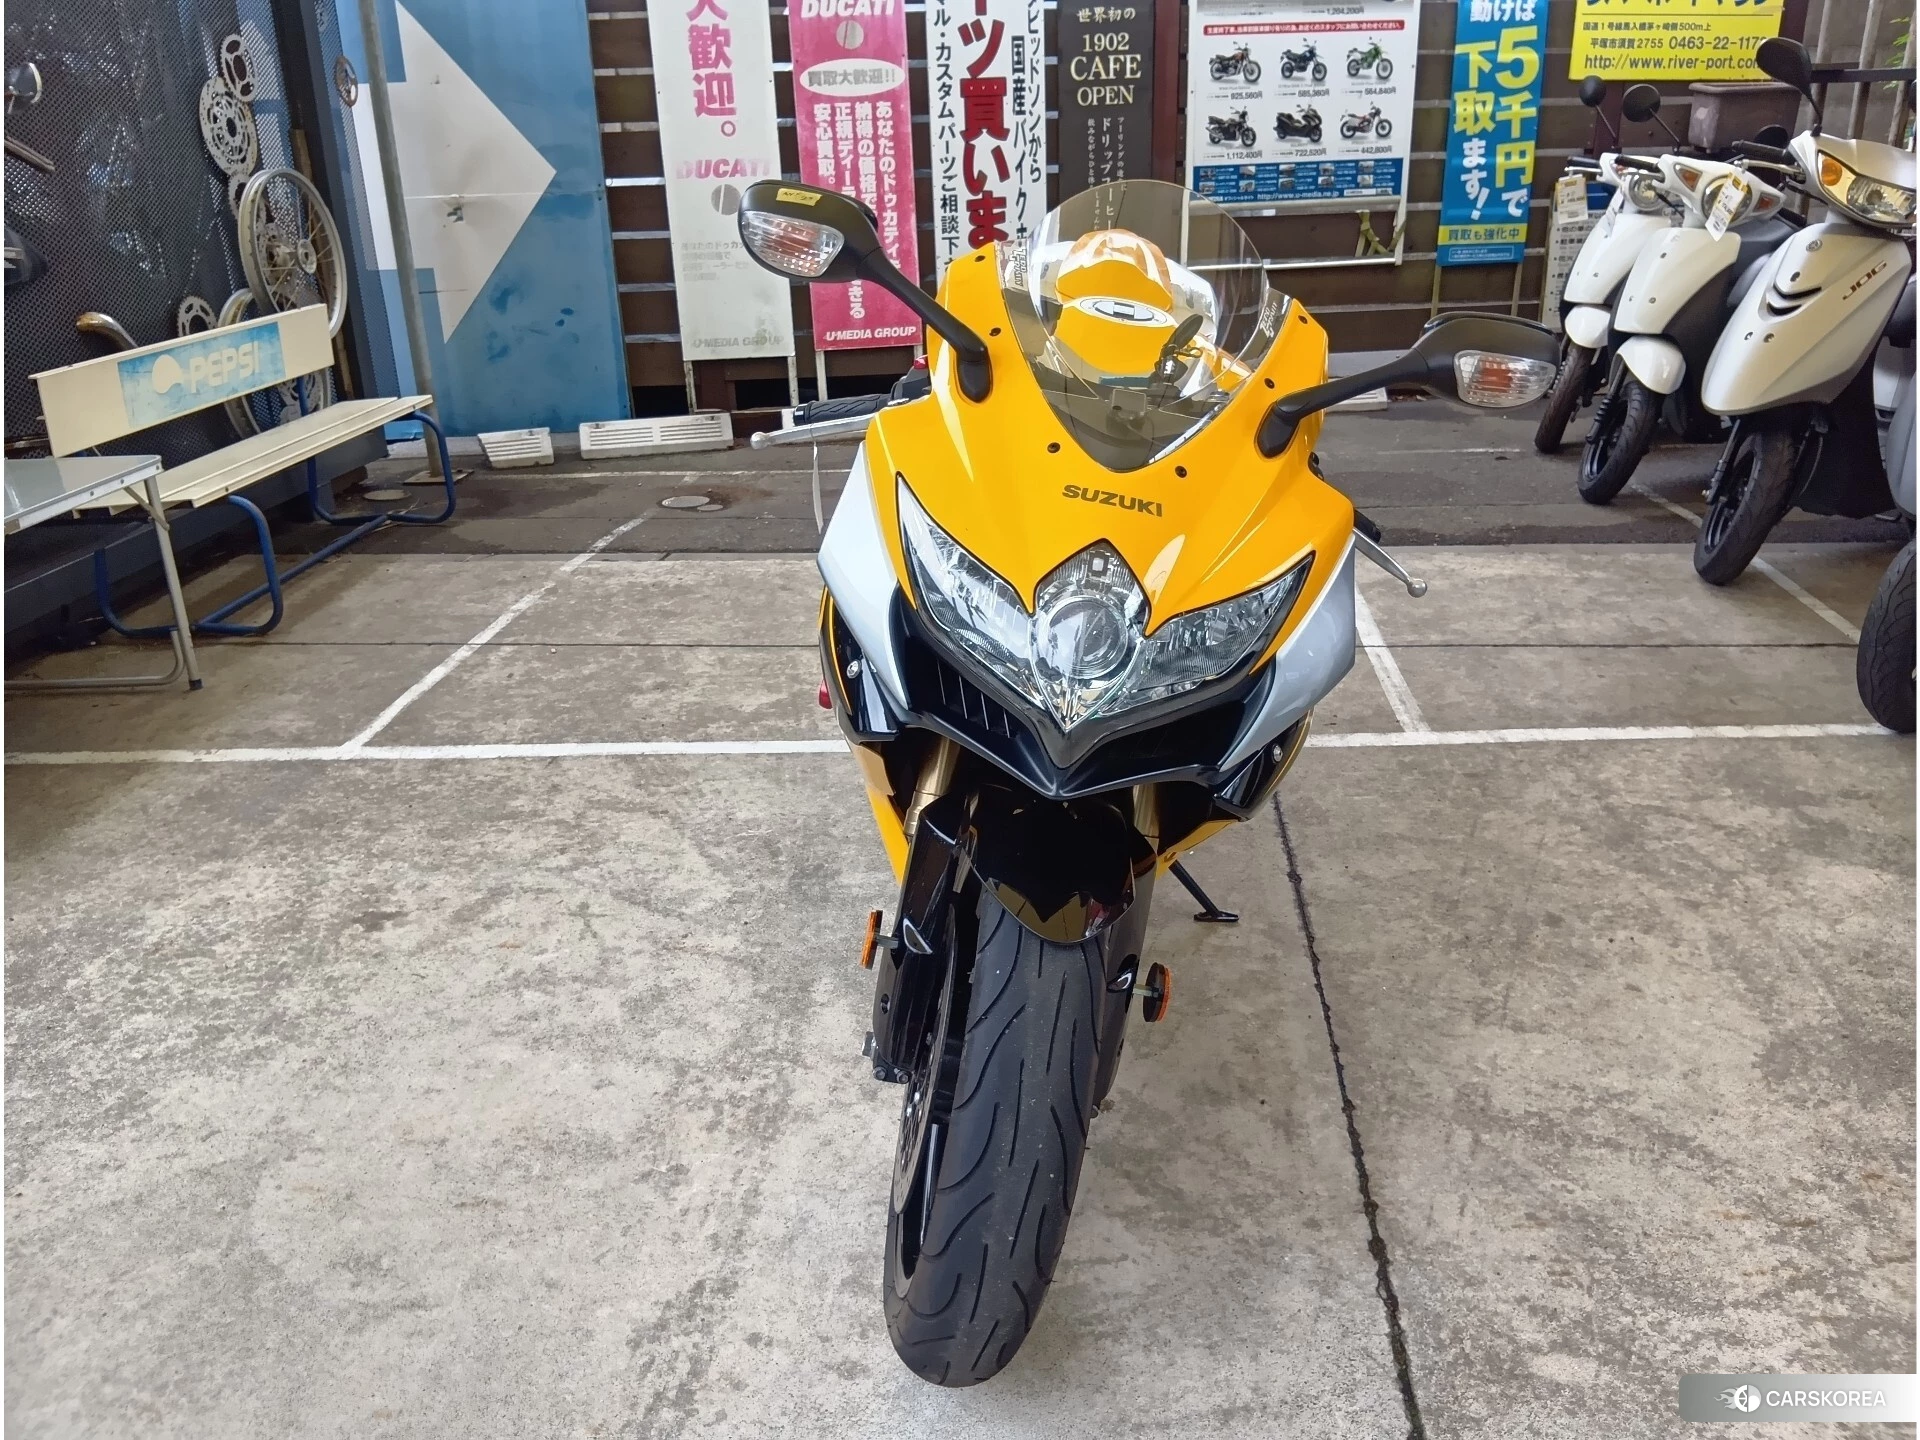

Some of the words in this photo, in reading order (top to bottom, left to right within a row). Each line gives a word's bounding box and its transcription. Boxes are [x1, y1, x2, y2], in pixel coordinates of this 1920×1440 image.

[800, 0, 896, 18] DUCATI
[1077, 6, 1136, 23] 世界初の
[1470, 0, 1538, 22] 動けば
[1082, 32, 1130, 52] 1902
[1070, 53, 1142, 81] CAFE
[1027, 0, 1042, 183] ビッドソンから
[1077, 85, 1135, 106] OPEN
[1494, 25, 1540, 217] 5千円で
[813, 103, 836, 184] 安心買取。
[934, 0, 960, 273] ル・カスタムパーツご相談下
[676, 158, 770, 179] DUCATI
[855, 101, 878, 217] 納得の価格で
[1842, 260, 1887, 300] JOG
[742, 335, 785, 347] GROUP
[874, 326, 917, 338] GROUP
[189, 341, 260, 393] PEPSI
[1062, 484, 1163, 518] SUZUKI
